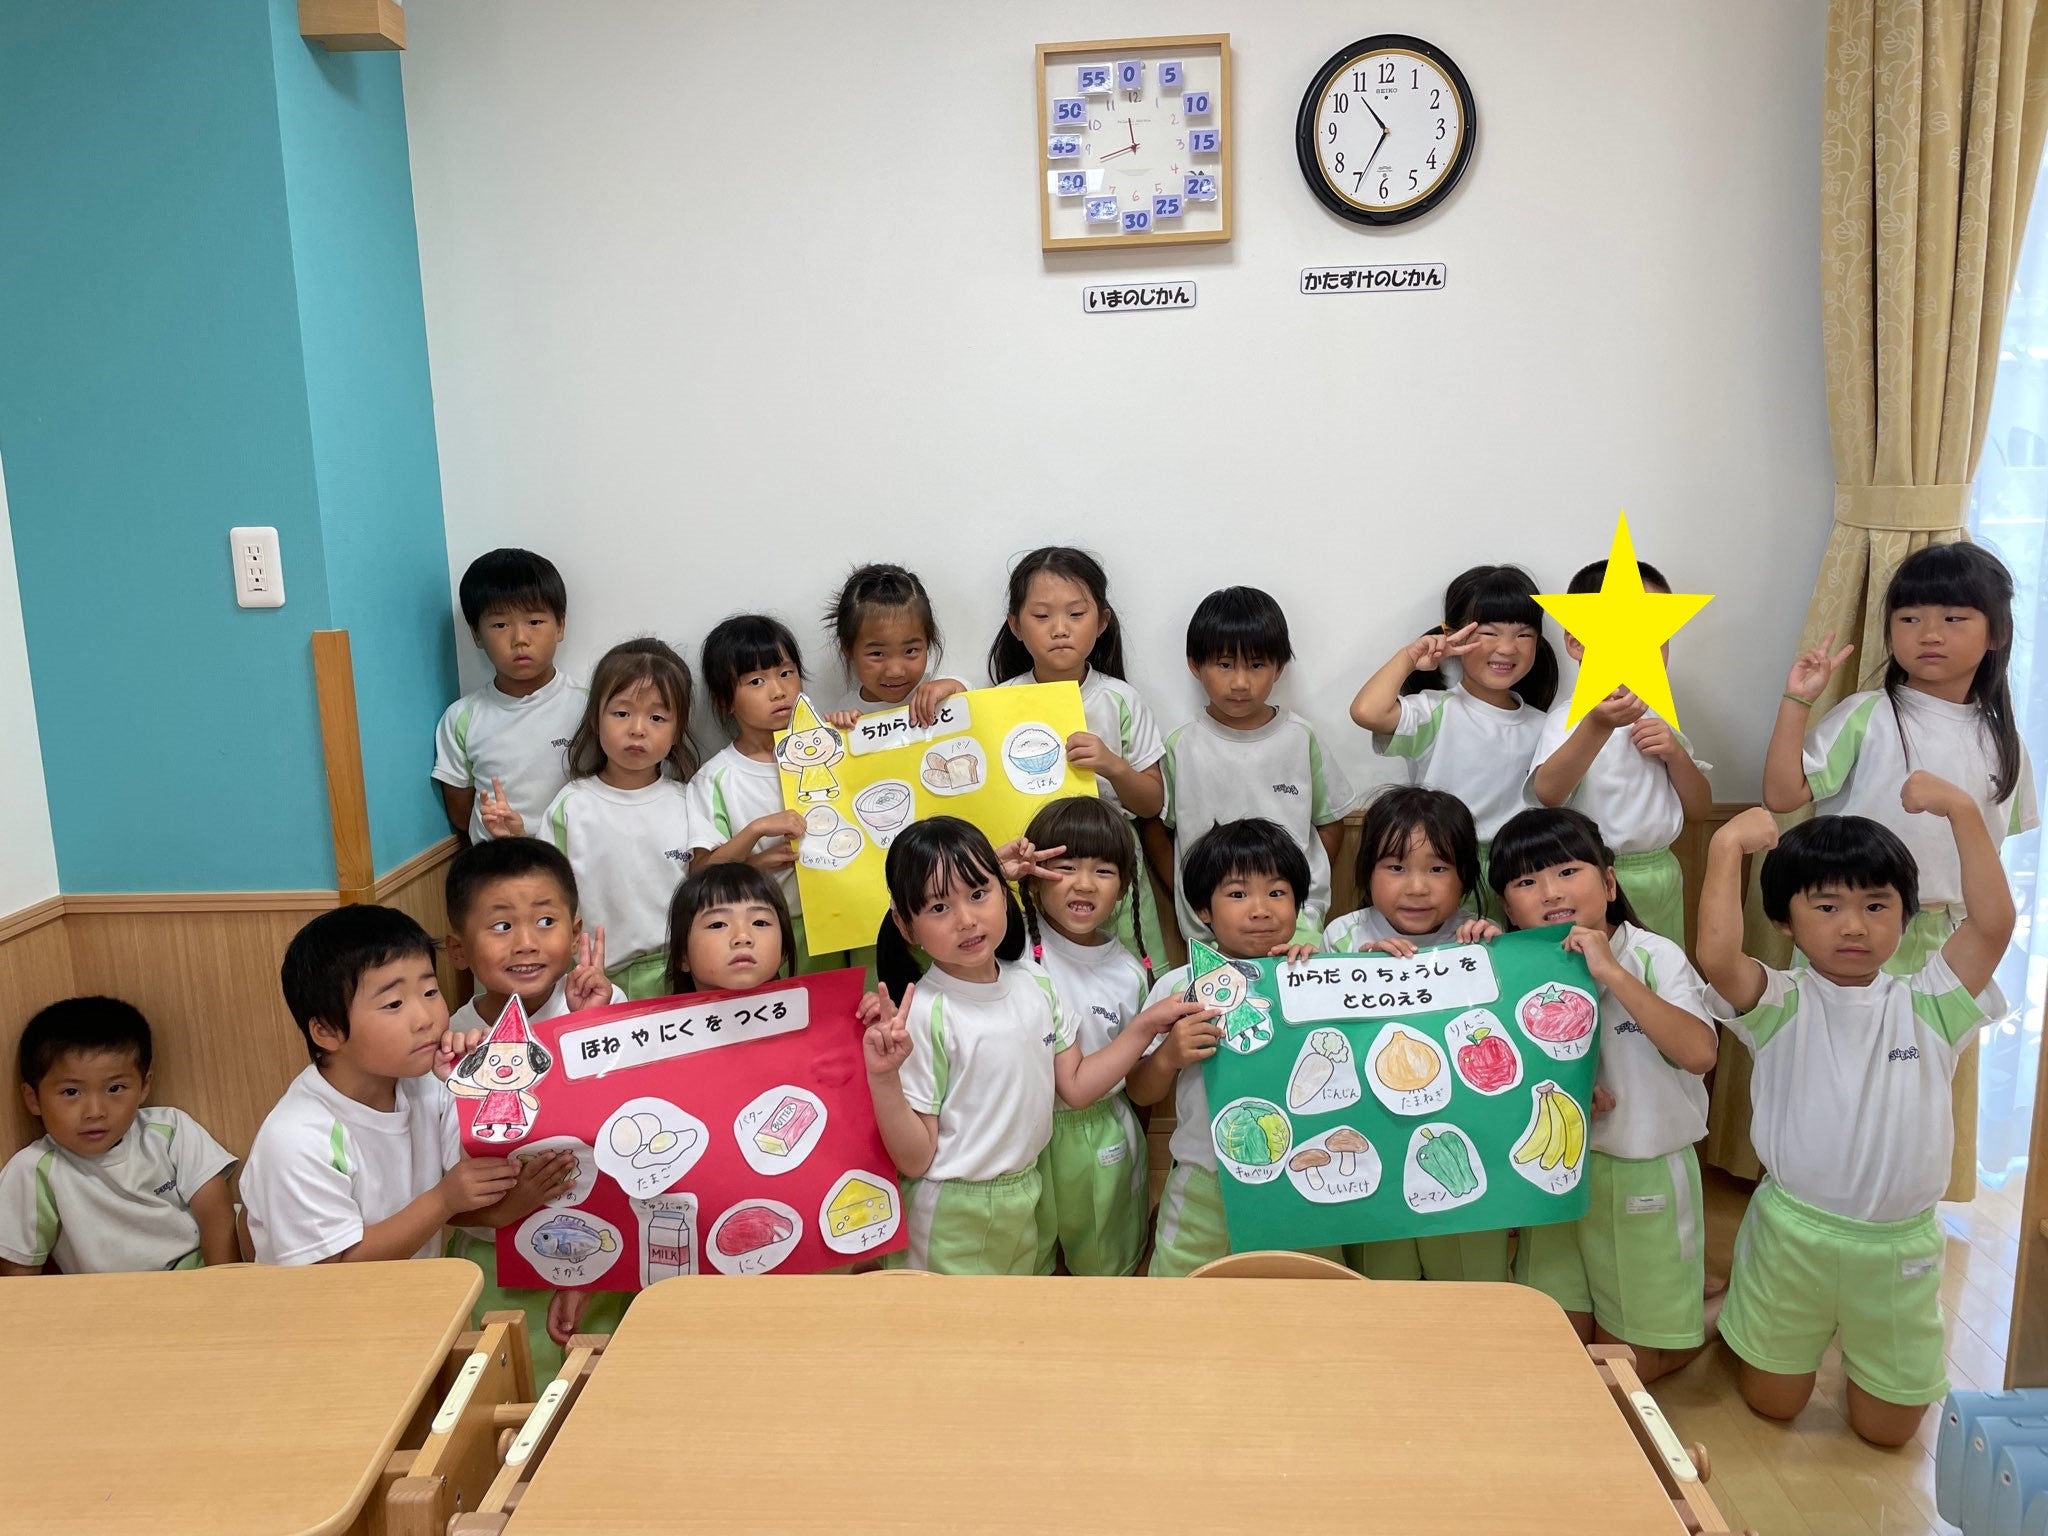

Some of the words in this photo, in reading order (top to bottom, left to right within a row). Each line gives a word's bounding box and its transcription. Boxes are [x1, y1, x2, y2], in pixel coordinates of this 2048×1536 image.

[1082, 71, 1106, 88] 55
[1123, 66, 1135, 83] 0
[1165, 67, 1176, 83] 5
[1353, 72, 1367, 92] 11
[1378, 63, 1395, 84] 12
[1411, 69, 1419, 89] 1
[1128, 91, 1142, 103] 12
[1186, 96, 1208, 113] 10
[1333, 93, 1349, 113] 10
[1430, 89, 1440, 109] 2
[1058, 102, 1082, 120] 50
[1170, 113, 1179, 125] 2
[1088, 119, 1101, 131] 10
[1328, 122, 1337, 144] 9
[1436, 118, 1446, 140] 3
[1176, 139, 1185, 150] 3
[1194, 134, 1214, 150] 15
[1335, 152, 1345, 173] 8
[1426, 147, 1436, 169] 4
[1171, 163, 1179, 174] 4
[1155, 183, 1163, 194] 5
[1353, 172, 1362, 193] 7
[1379, 177, 1389, 199] 6
[1408, 170, 1418, 190] 5
[1132, 190, 1140, 201] 6
[1156, 199, 1179, 215] 25
[1125, 212, 1148, 229] 30
[1304, 267, 1442, 291] かたずけのじかん
[1089, 286, 1190, 309] いまのじかん
[951, 740, 970, 754] パン
[1027, 778, 1058, 790] ごはん
[803, 856, 838, 868] じゃがいも
[1287, 967, 1341, 988] からだ
[1351, 968, 1368, 983] の
[1377, 962, 1449, 983] ちょうし
[1459, 957, 1477, 972] を
[1343, 988, 1433, 1009] ととのえる
[581, 1036, 621, 1060] ほね
[631, 1028, 650, 1047] や
[659, 1018, 695, 1043] にく
[705, 1014, 723, 1032] を
[734, 1001, 787, 1025] つくる
[1450, 1010, 1485, 1037] りんご
[1553, 1043, 1582, 1057] トマト
[1322, 1088, 1359, 1100] にんじん
[1401, 1088, 1444, 1110] たまねぎ
[739, 1111, 763, 1131] バター
[772, 1105, 795, 1130] BUTTER
[637, 1166, 672, 1191] たまご
[1235, 1166, 1273, 1180] キャベツ
[1551, 1169, 1577, 1191] バナナ
[1327, 1180, 1370, 1195] しいたけ
[1409, 1191, 1447, 1207] ピーマン
[861, 1225, 887, 1247] チーズ
[652, 1248, 679, 1261] MILK
[552, 1265, 585, 1280] さかな
[739, 1255, 766, 1274] にく
